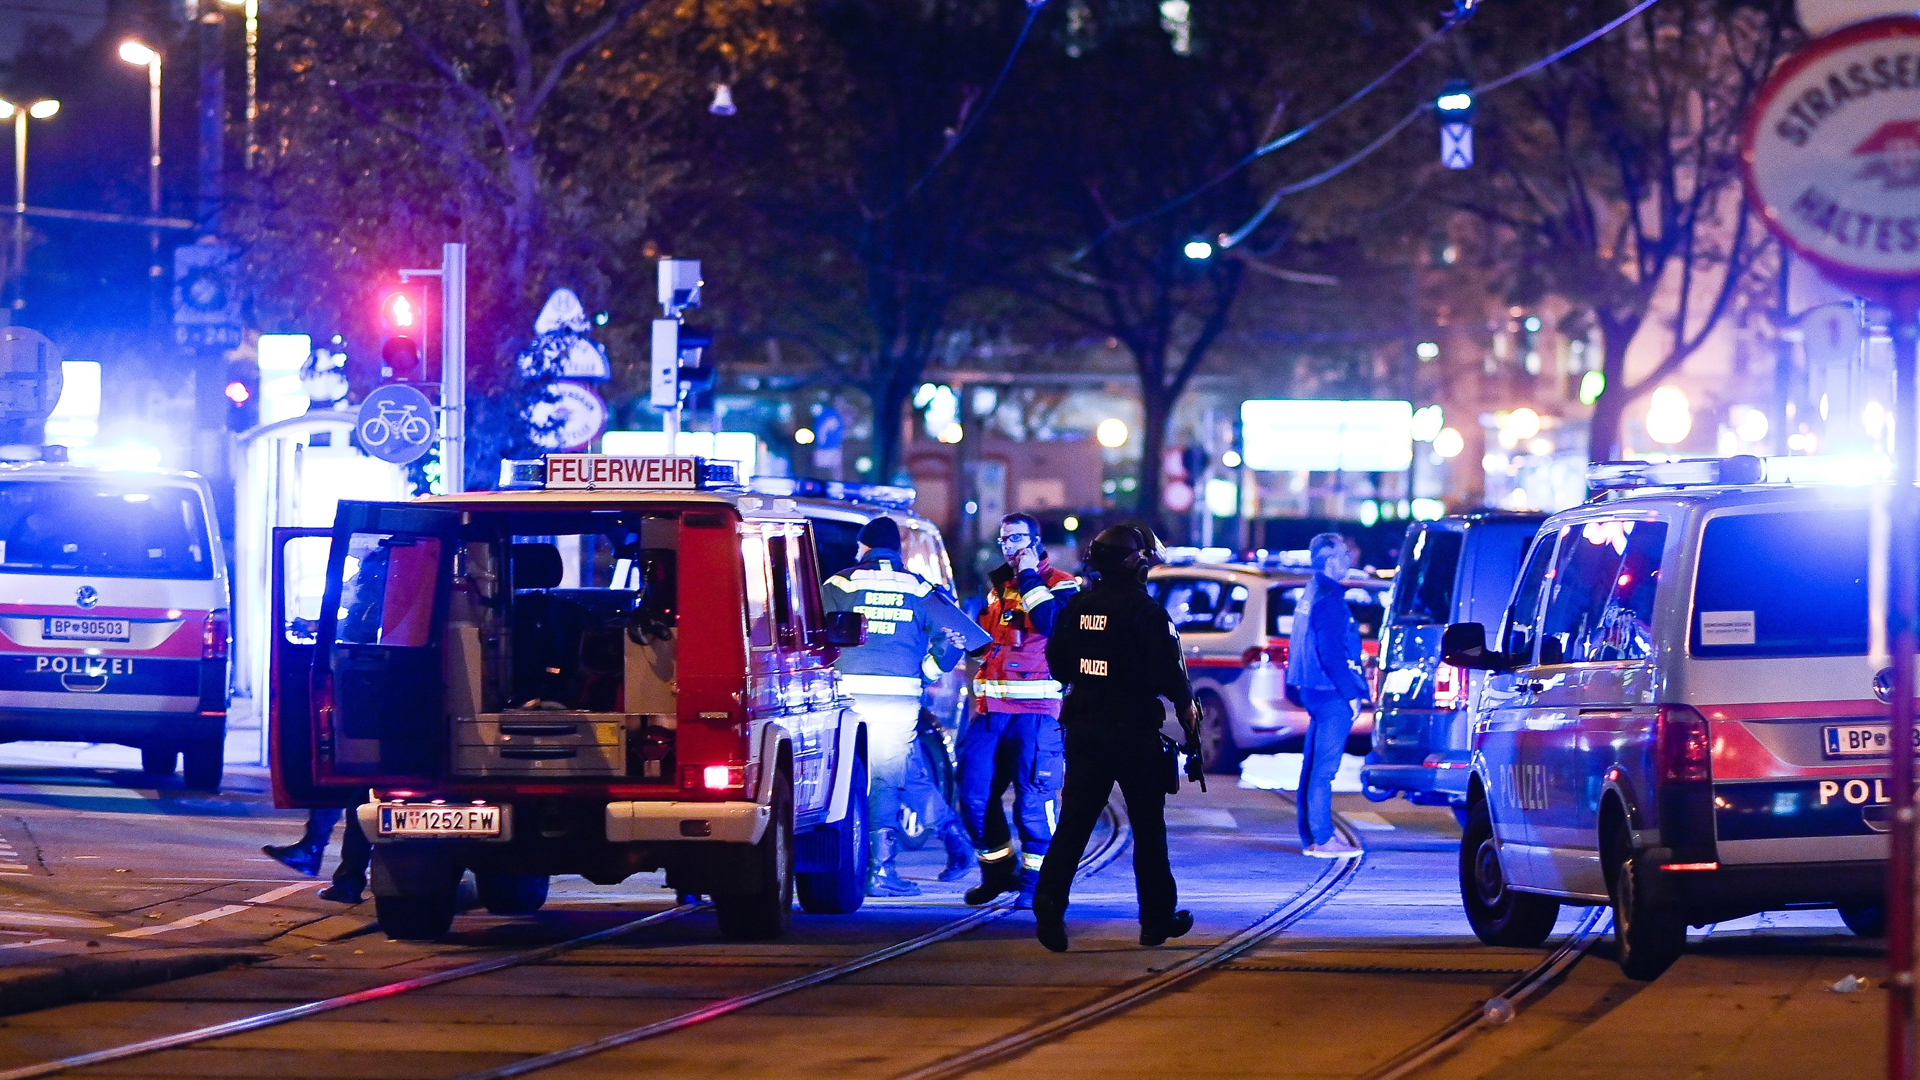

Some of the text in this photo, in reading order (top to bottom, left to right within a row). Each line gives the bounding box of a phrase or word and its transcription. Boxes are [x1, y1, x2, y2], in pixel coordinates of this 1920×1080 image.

[1775, 53, 1920, 147] STRASSE
[549, 459, 693, 482] FEUERWEHR
[55, 620, 122, 634] BP 90503
[1080, 614, 1107, 631] POLIZEI
[36, 656, 133, 674] POLIZEI
[1080, 658, 1108, 677] POLIZEI
[1849, 730, 1872, 749] BP
[1500, 764, 1549, 810] POLIZEI
[1819, 779, 1891, 804] POL
[394, 812, 407, 829] W
